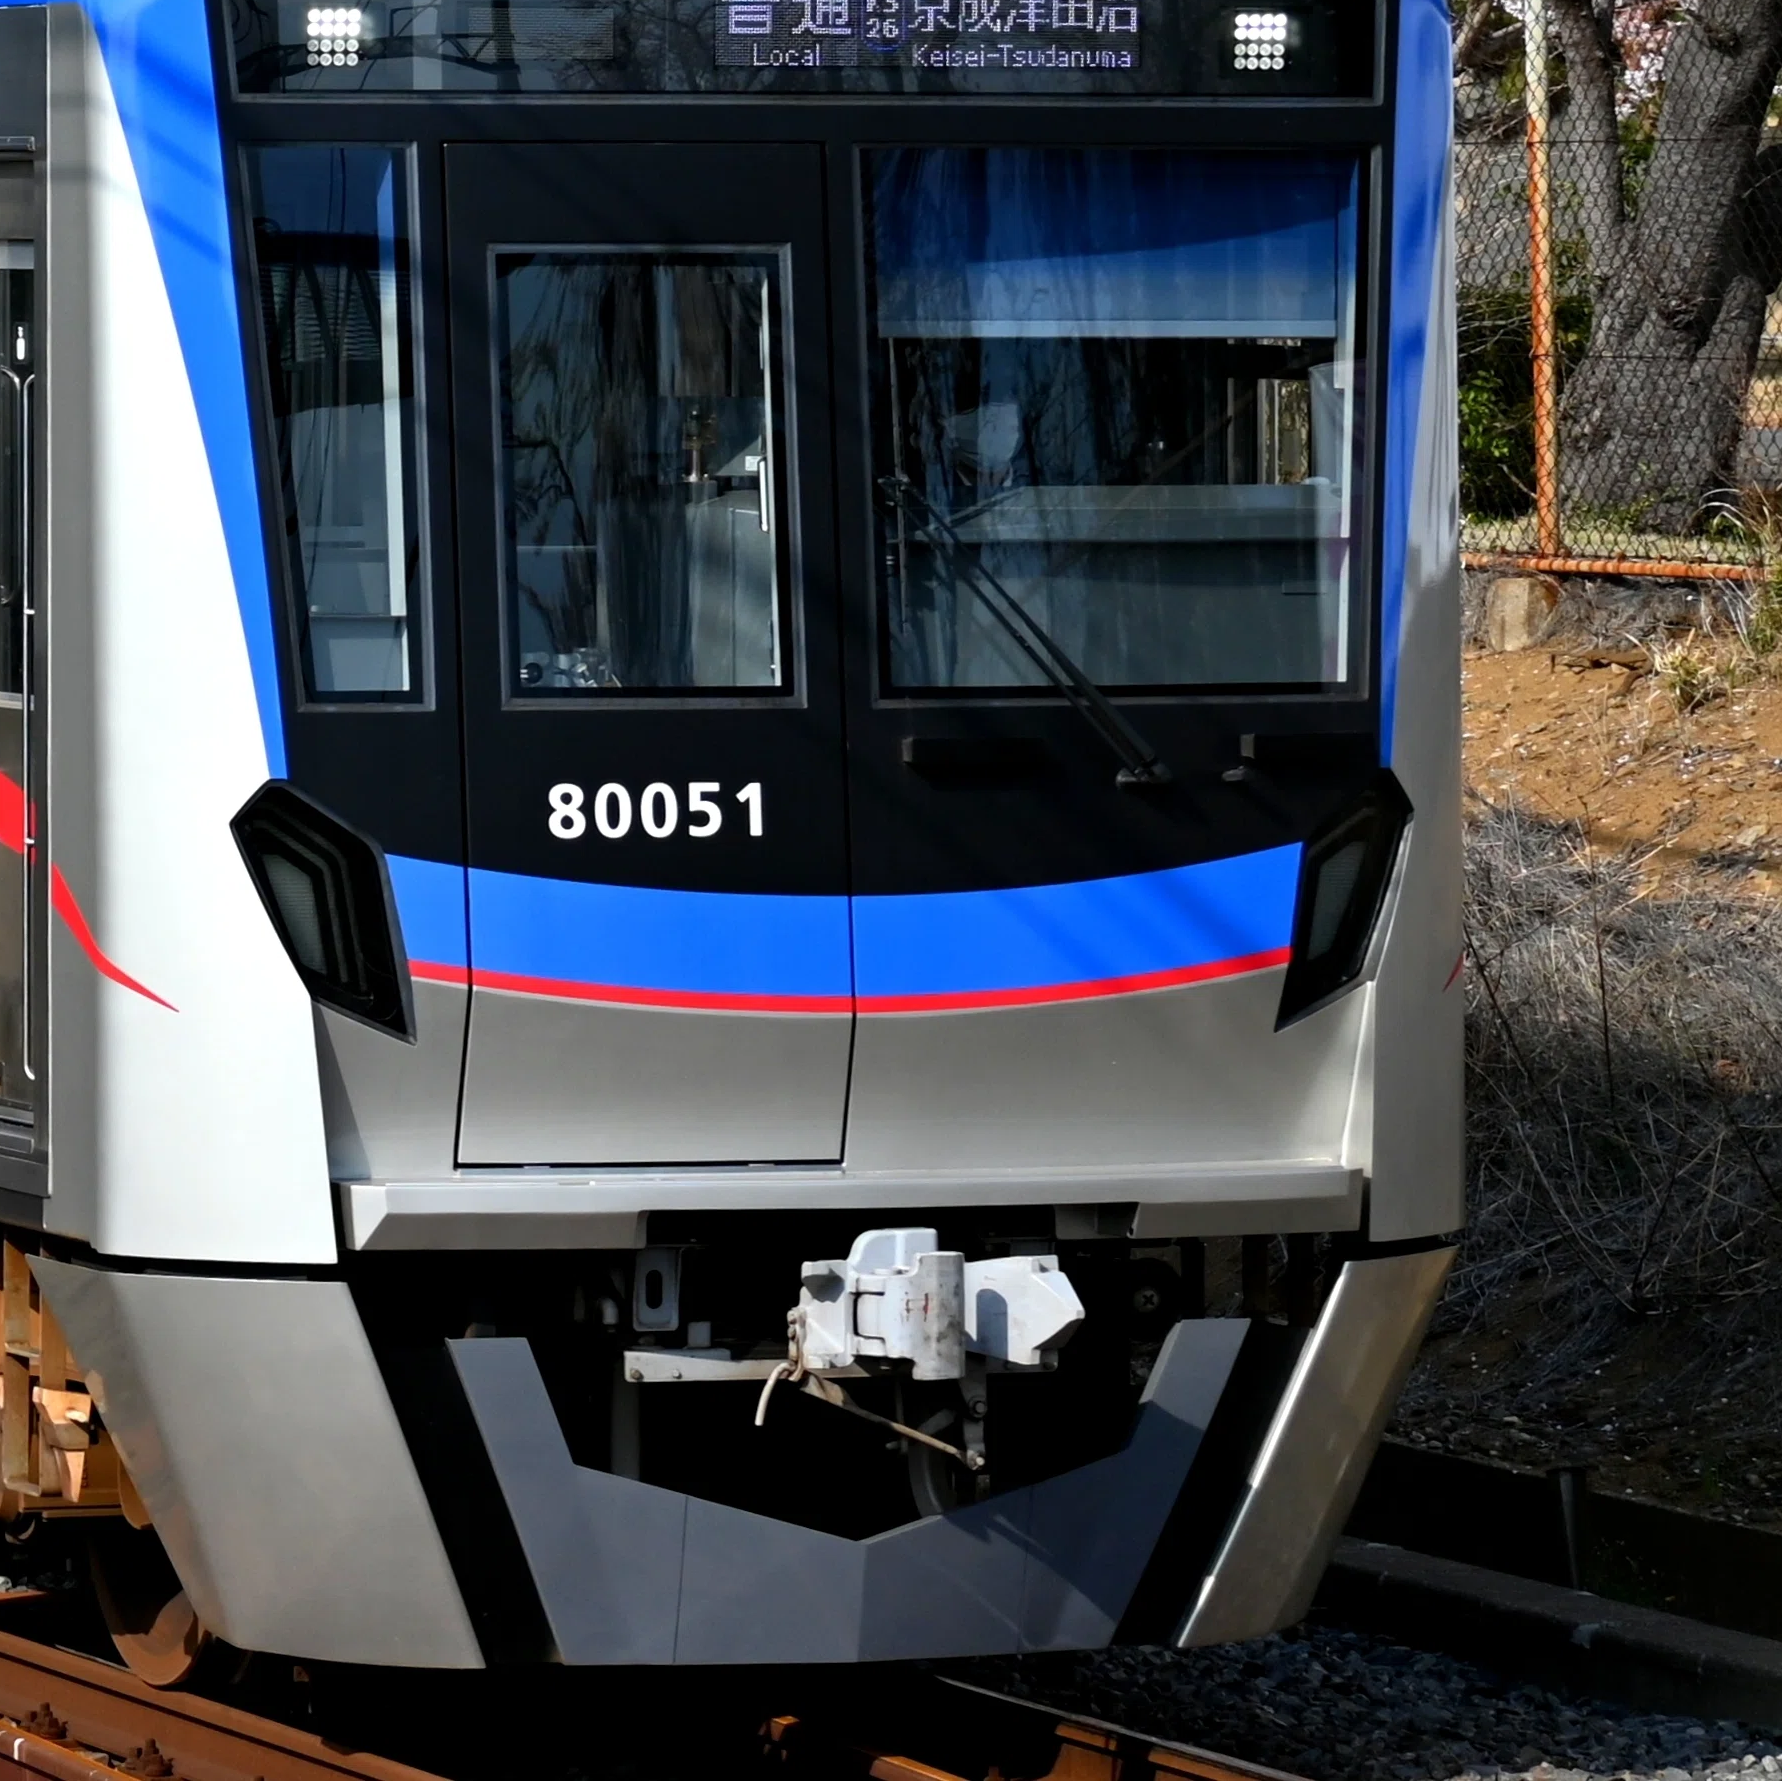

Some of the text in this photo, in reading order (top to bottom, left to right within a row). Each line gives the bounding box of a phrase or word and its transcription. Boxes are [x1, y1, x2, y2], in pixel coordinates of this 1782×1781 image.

[866, 18, 899, 39] 26
[752, 43, 821, 67] Local
[912, 44, 1133, 68] Keisei-Tsudanuma
[547, 781, 764, 840] 80051
